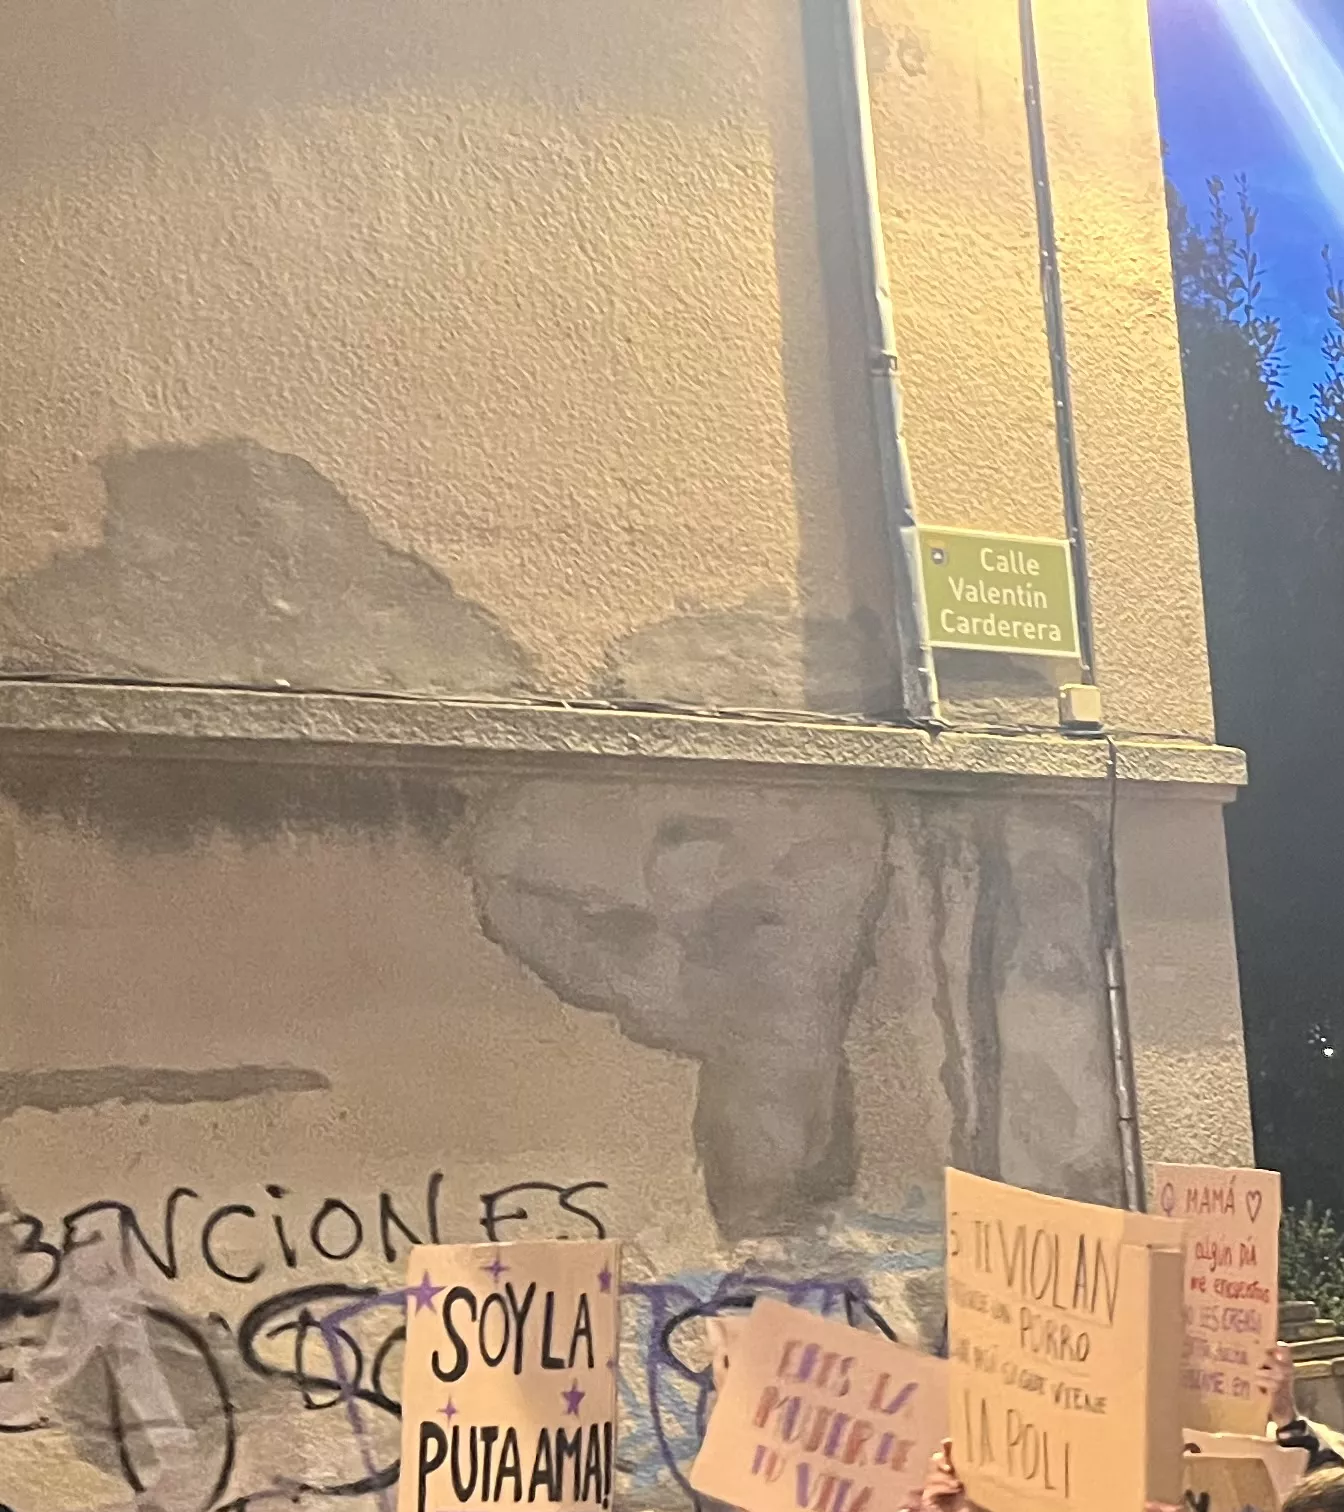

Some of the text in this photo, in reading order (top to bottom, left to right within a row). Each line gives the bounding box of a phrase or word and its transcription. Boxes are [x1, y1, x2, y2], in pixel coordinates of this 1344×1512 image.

[980, 547, 1040, 577] Calle
[940, 609, 1062, 641] Carderera
[1186, 1174, 1236, 1216] MAMÁ
[996, 1219, 1124, 1327] VIOLAN
[431, 1281, 537, 1383] SOY
[541, 1291, 595, 1370] LA
[527, 1420, 613, 1510] AMA!
[1006, 1408, 1070, 1498] POLI
